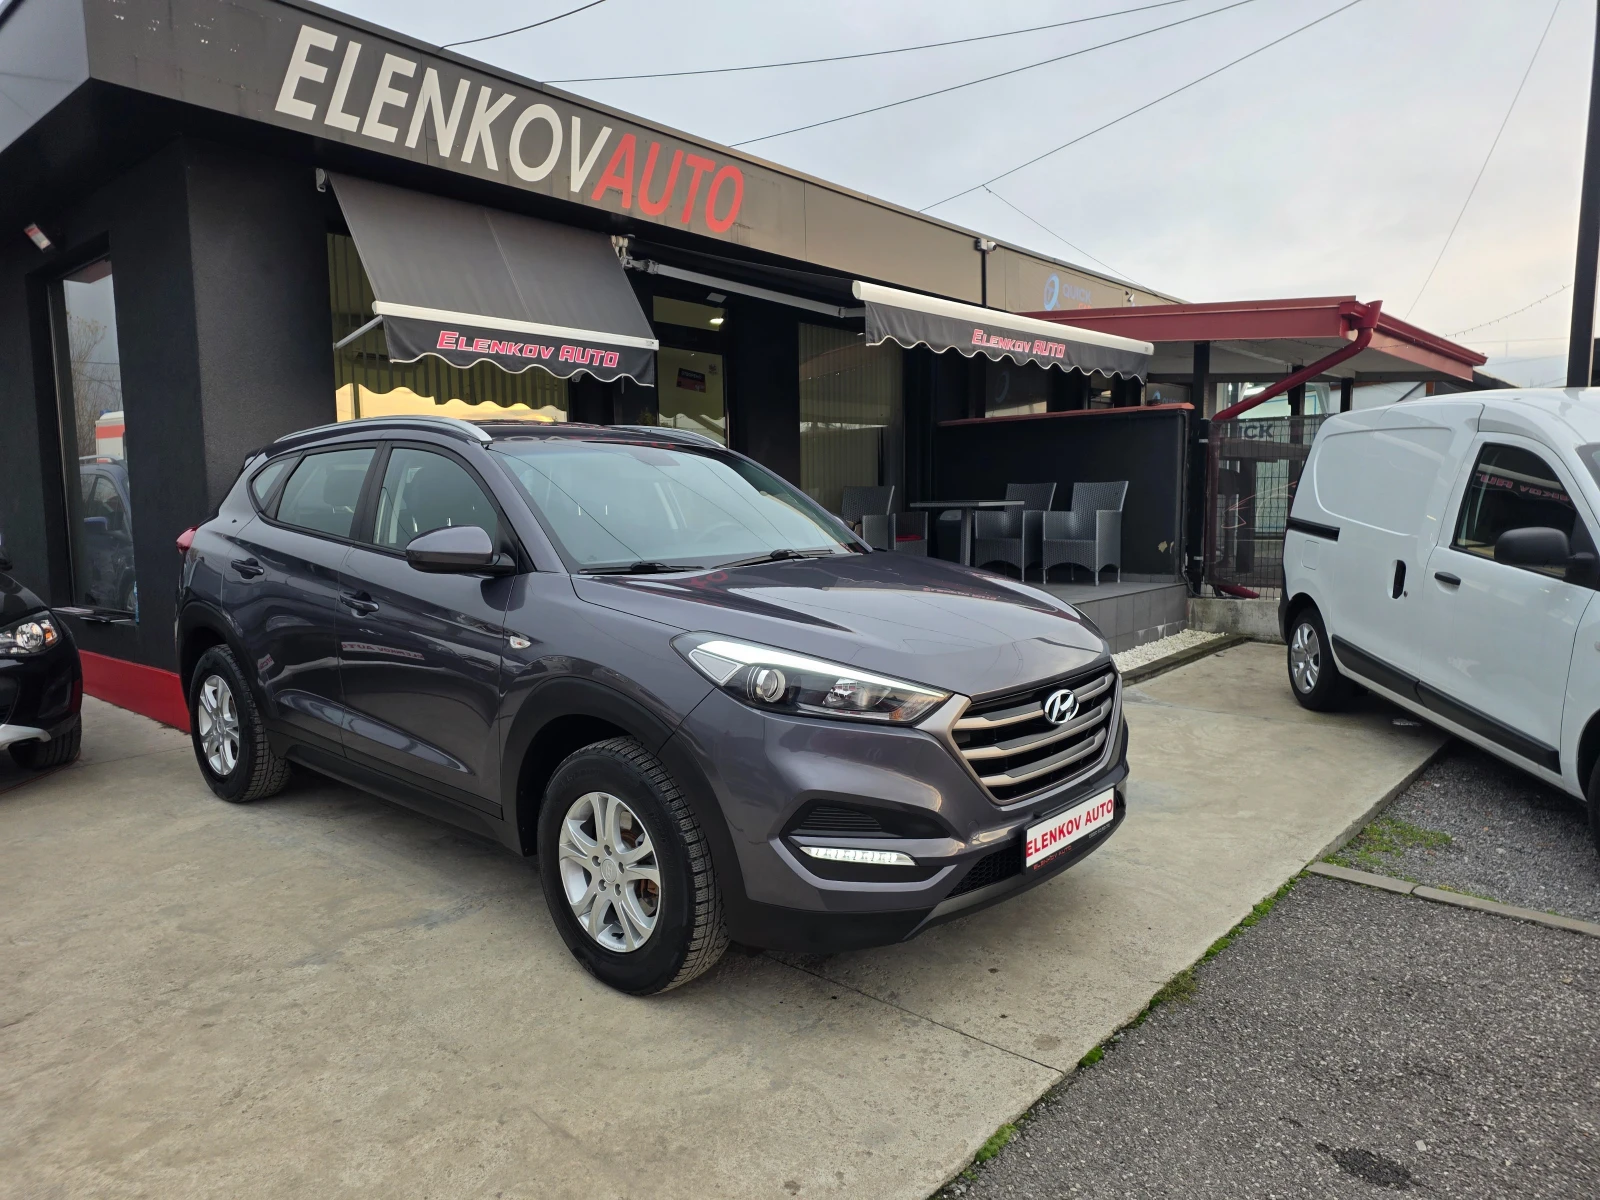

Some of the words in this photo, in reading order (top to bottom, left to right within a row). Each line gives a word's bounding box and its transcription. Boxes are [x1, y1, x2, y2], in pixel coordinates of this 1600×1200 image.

[1062, 284, 1092, 305] QUICK
[436, 331, 554, 359] ELENKOV
[558, 345, 620, 368] AUTO
[971, 328, 1032, 353] ELENKOV
[1032, 340, 1066, 358] AUTO
[1026, 815, 1082, 858] ELENKOV
[1085, 799, 1113, 826] AUTO
